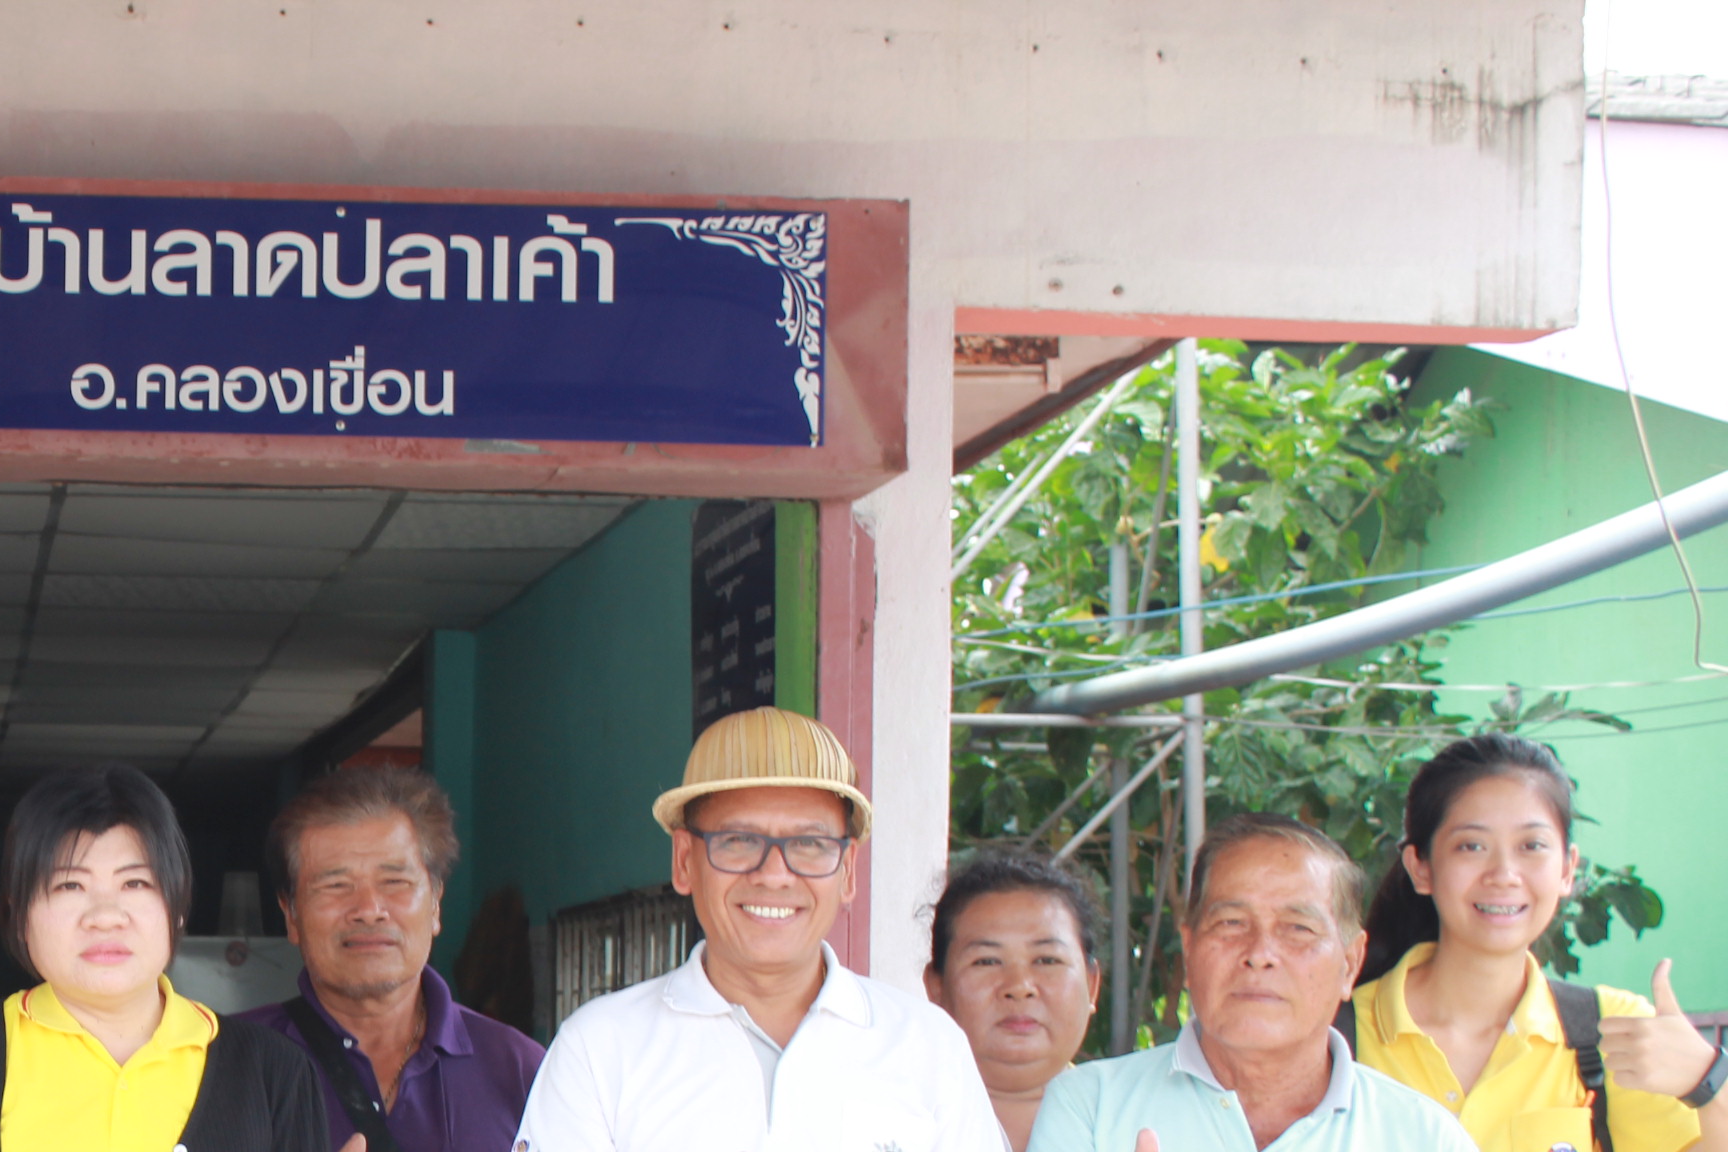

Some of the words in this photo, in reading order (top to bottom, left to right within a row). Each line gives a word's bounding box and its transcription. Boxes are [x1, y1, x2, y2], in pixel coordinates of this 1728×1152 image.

[71, 345, 454, 415] อ.คลองเขื่อน
